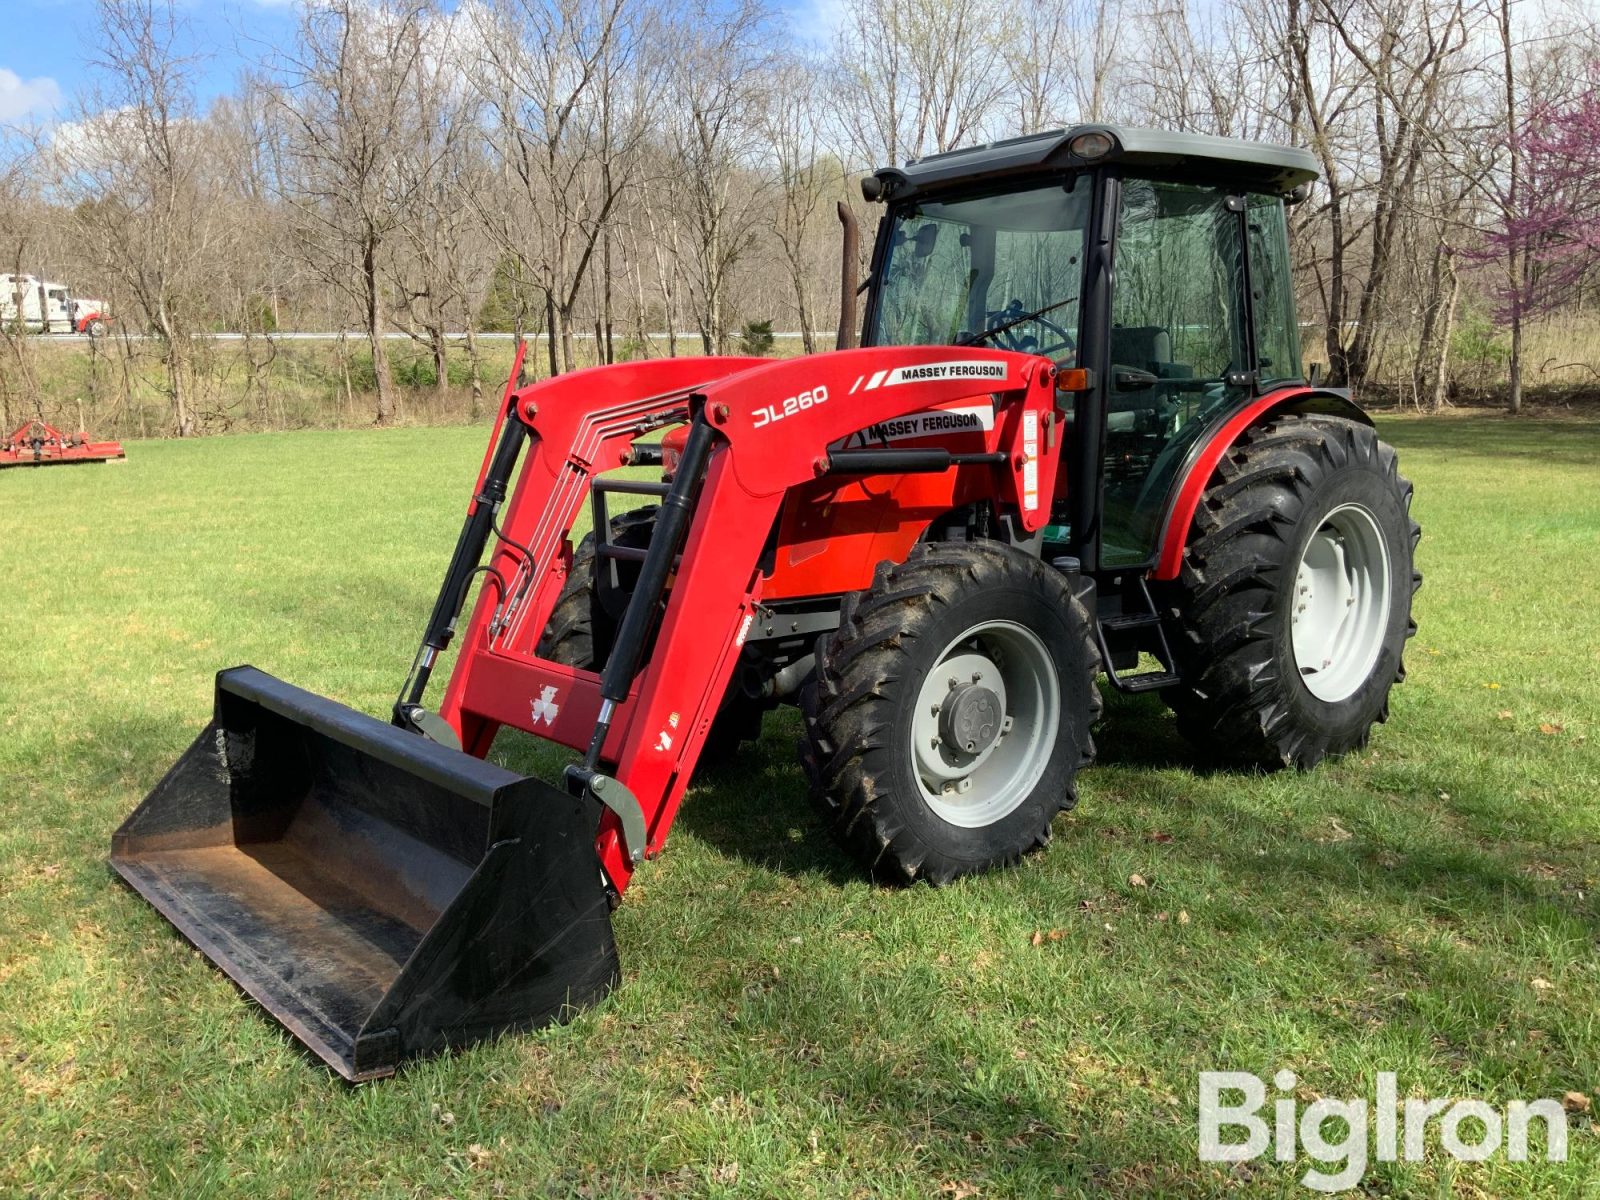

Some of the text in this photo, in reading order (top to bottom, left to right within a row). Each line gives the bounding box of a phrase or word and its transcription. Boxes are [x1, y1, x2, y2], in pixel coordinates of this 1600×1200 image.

[902, 364, 1003, 380] MASSEY FERGUSON
[752, 385, 829, 428] DL260
[922, 413, 977, 431] FERGUSON
